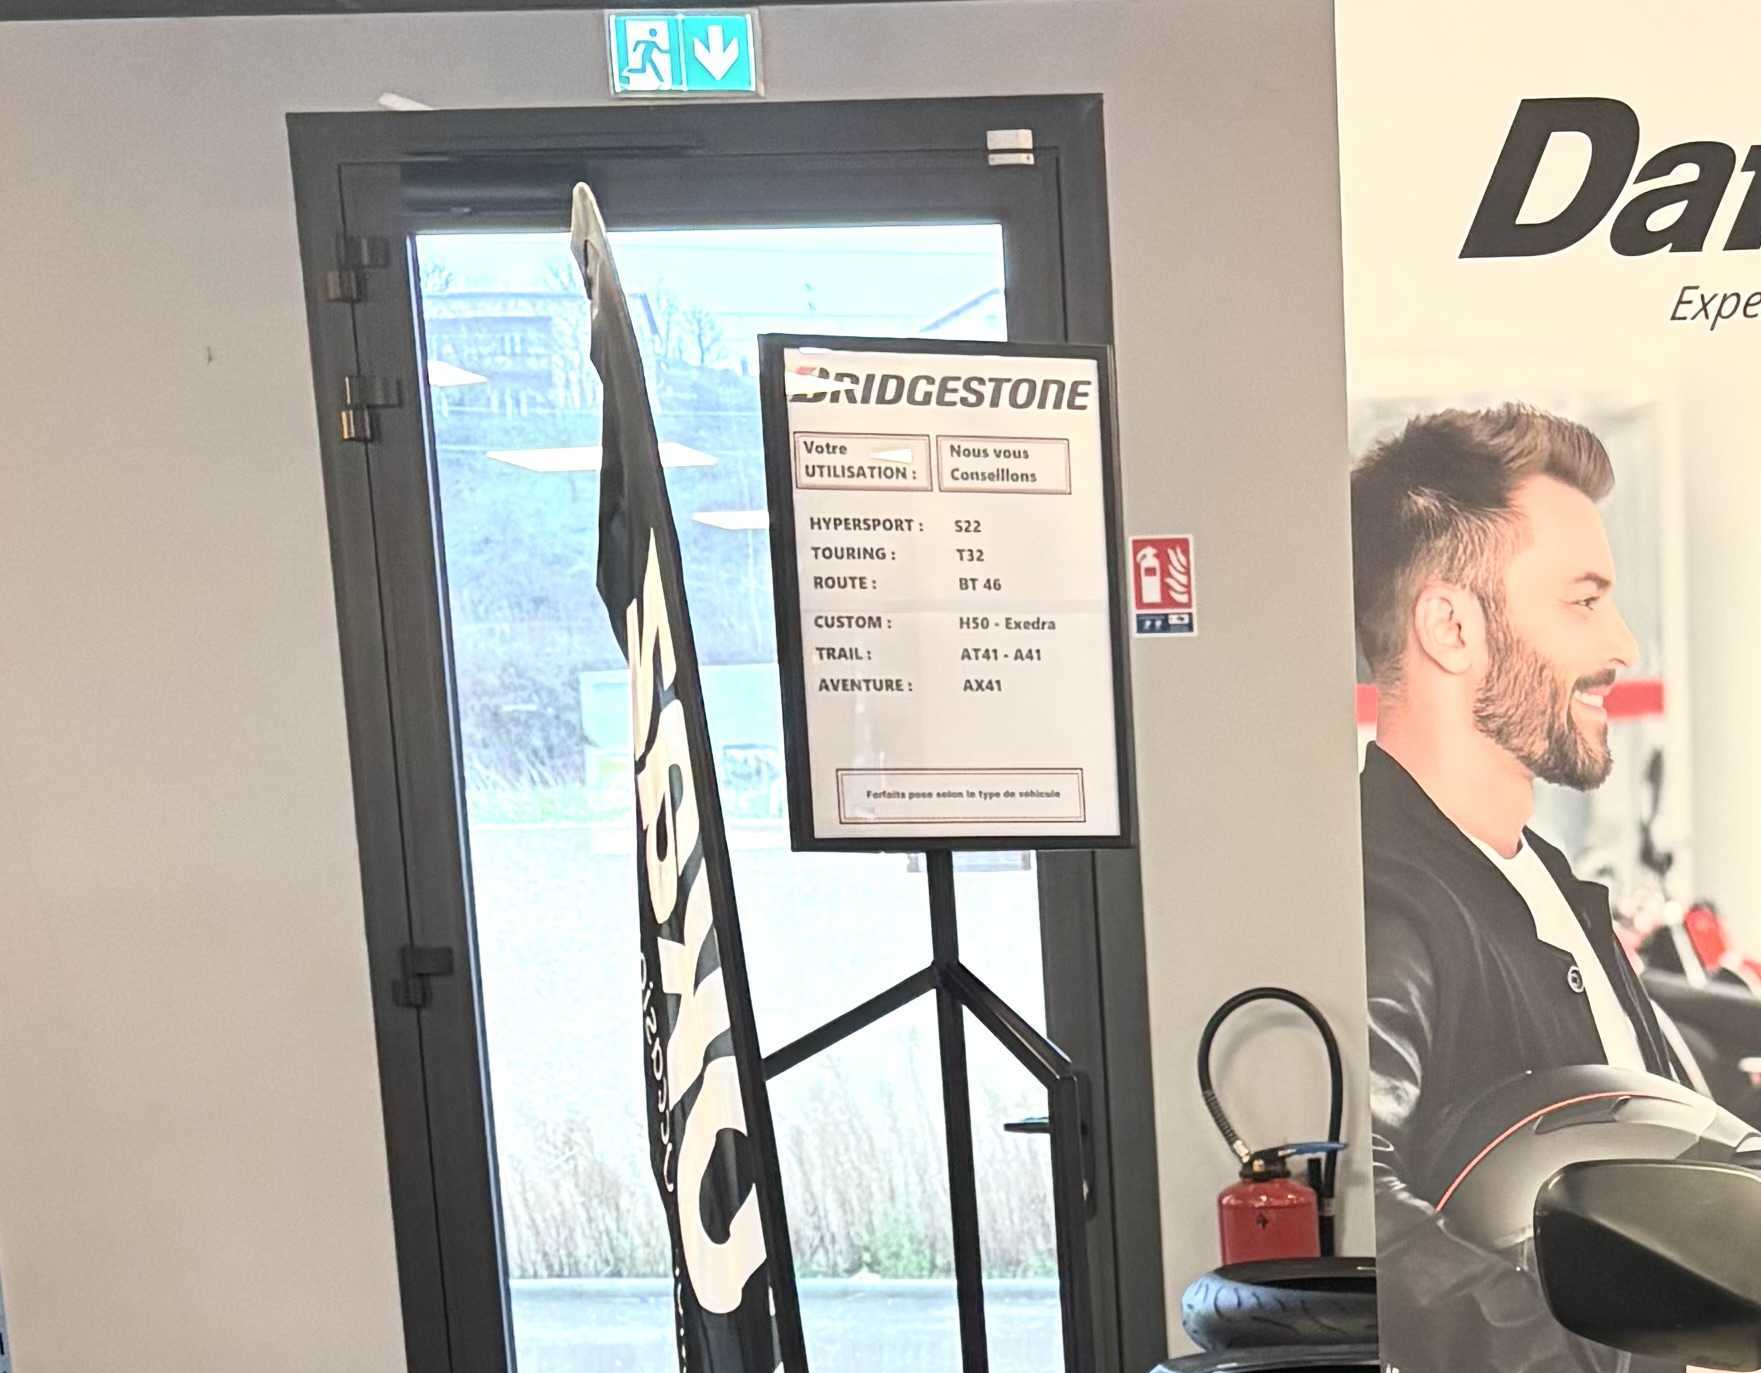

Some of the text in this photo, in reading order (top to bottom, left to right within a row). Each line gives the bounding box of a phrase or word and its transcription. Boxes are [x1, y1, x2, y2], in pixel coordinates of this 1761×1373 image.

[789, 366, 1092, 411] BRIDGESTONE
[803, 441, 847, 454] Votre
[950, 445, 1029, 459] Nous vous
[805, 465, 906, 479] UTILISATION
[951, 468, 1036, 482] Conseillons
[810, 517, 913, 531] HYPERSPORT
[955, 520, 981, 532] S22
[811, 547, 886, 560] TOURING
[957, 549, 984, 561] T32
[814, 576, 867, 589] ROUTE
[959, 578, 1001, 590] BT 46
[814, 616, 881, 628] CUSTOM
[960, 617, 989, 629] H50
[1005, 617, 1055, 630] Exedra
[816, 647, 862, 660] TRAIL
[961, 648, 997, 660] AT41
[1014, 649, 1041, 661] A41
[819, 679, 903, 691] AVENTURE
[964, 680, 1001, 691] AX41
